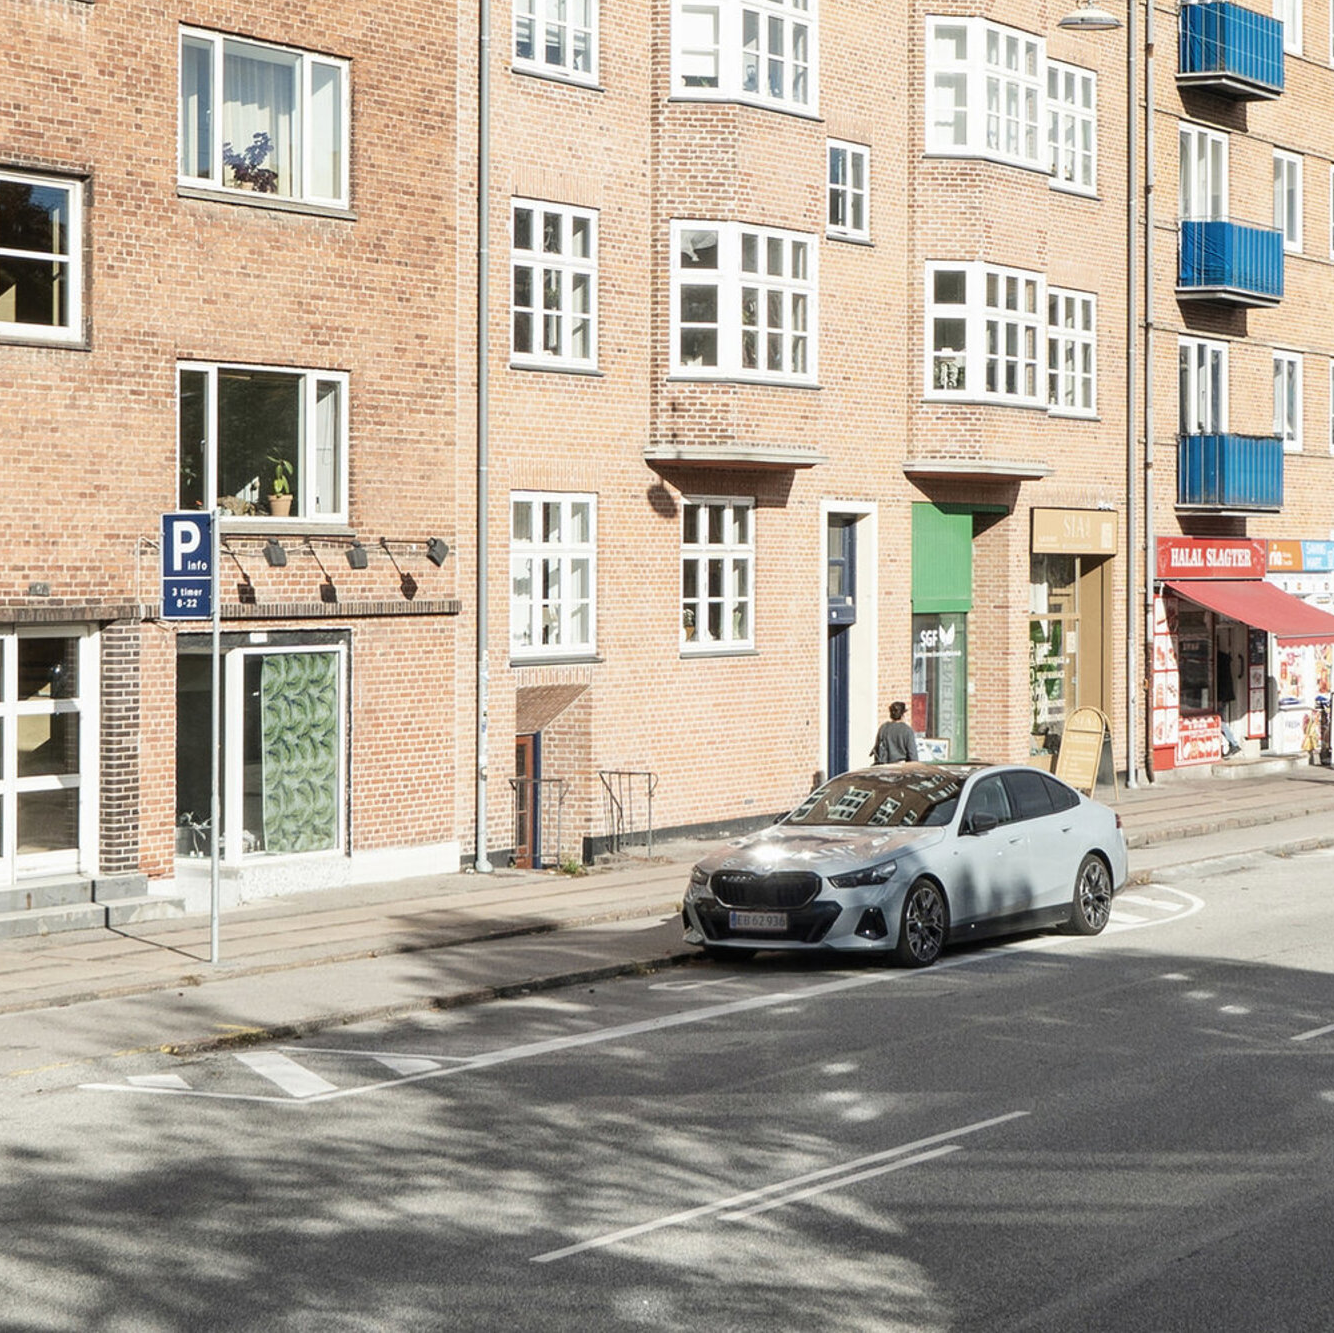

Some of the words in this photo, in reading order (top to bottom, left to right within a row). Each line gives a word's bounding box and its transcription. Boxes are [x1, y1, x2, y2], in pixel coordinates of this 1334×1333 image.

[172, 520, 202, 572] P
[187, 559, 209, 571] info
[1170, 547, 1205, 568] HALAL
[1205, 547, 1253, 568] SLAGTER
[171, 587, 179, 598] 3
[180, 587, 203, 597] timer
[175, 598, 199, 609] 8-22
[919, 629, 938, 648] SGF
